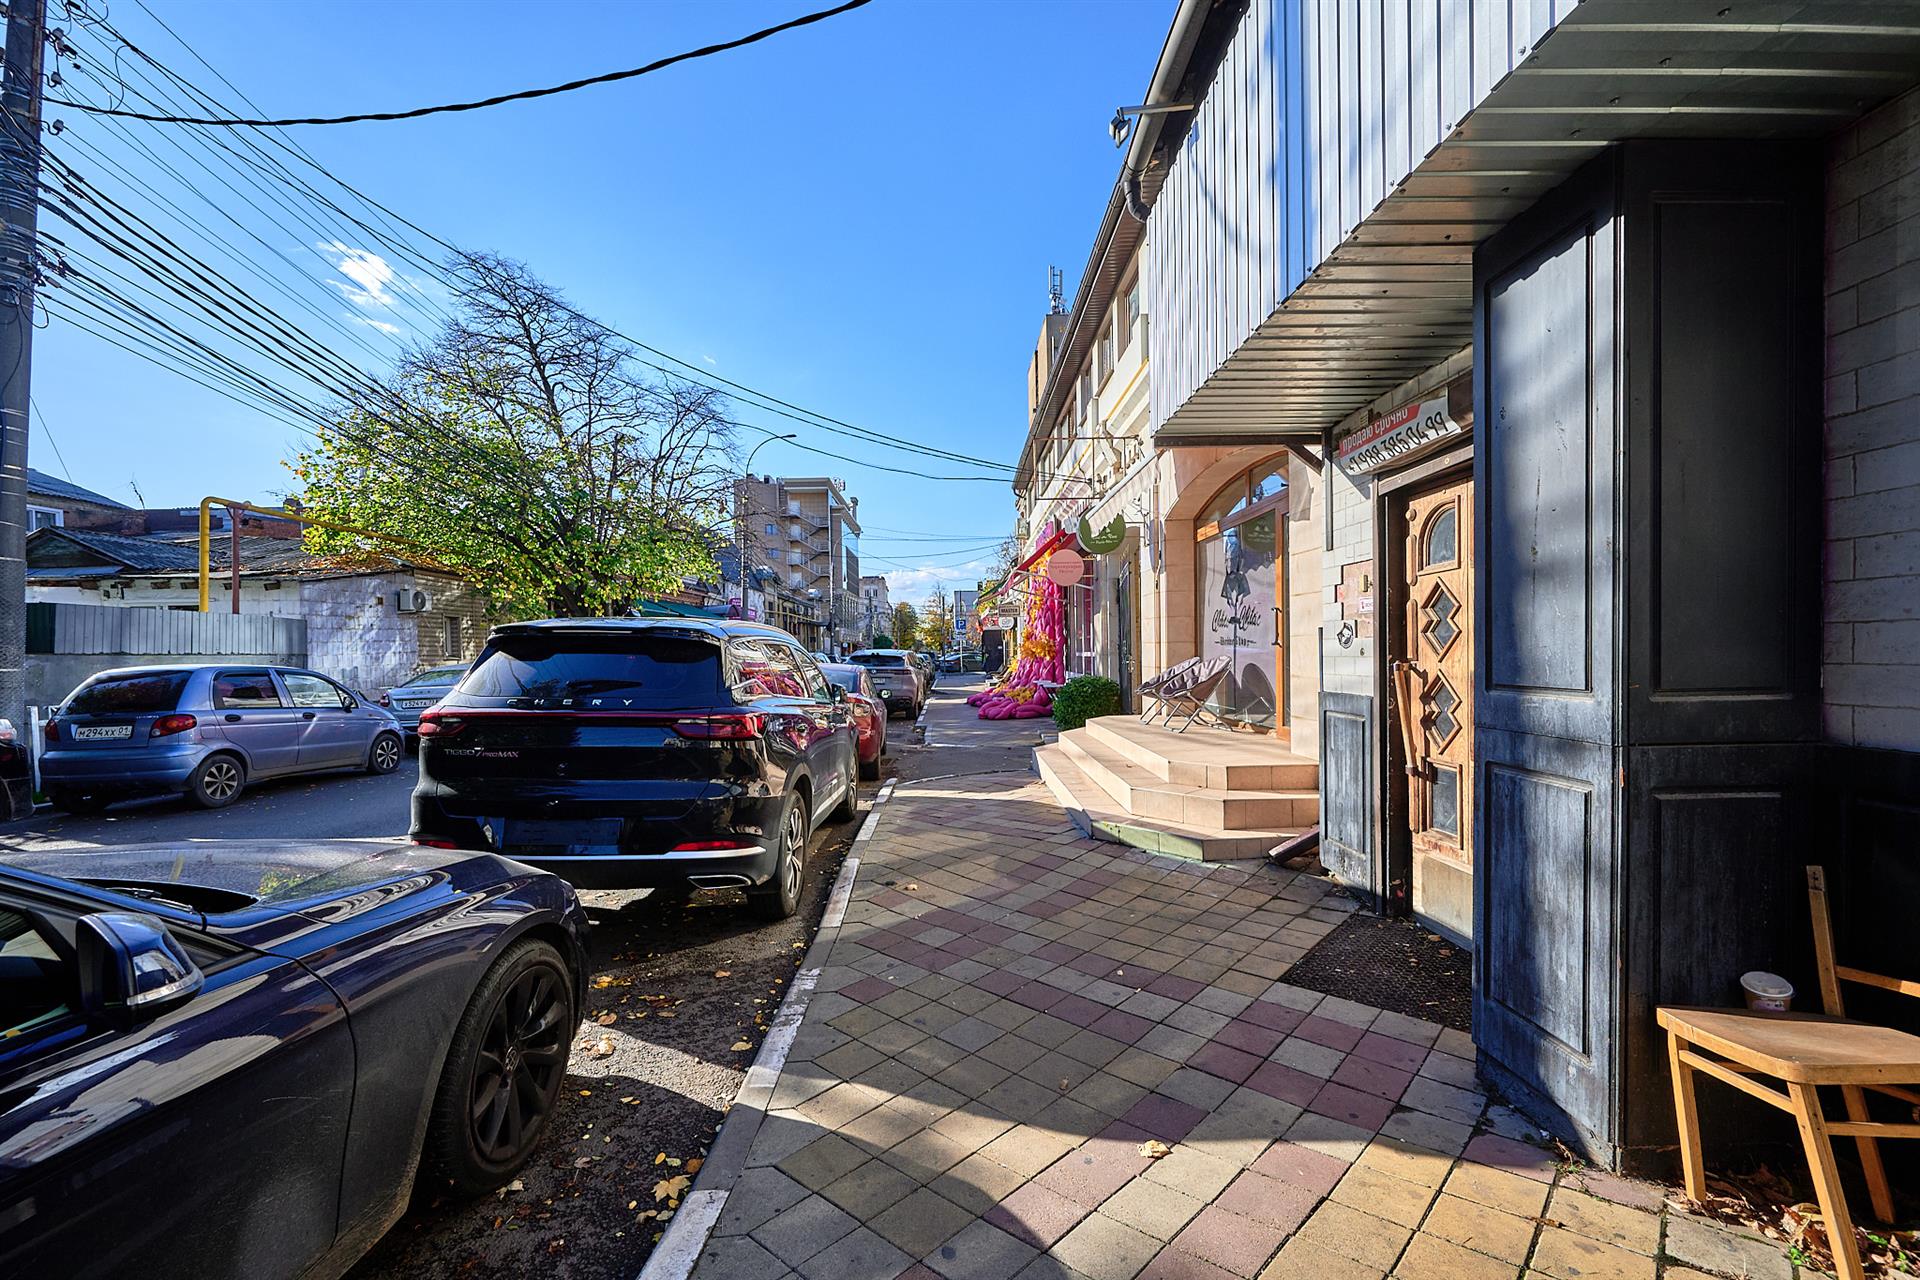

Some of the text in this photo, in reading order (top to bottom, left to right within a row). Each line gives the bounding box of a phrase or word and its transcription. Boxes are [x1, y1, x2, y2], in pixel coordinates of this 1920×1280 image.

[1342, 426, 1373, 452] продаю
[1348, 411, 1449, 472] +7 988 385 04 99
[444, 748, 475, 756] TIGGO
